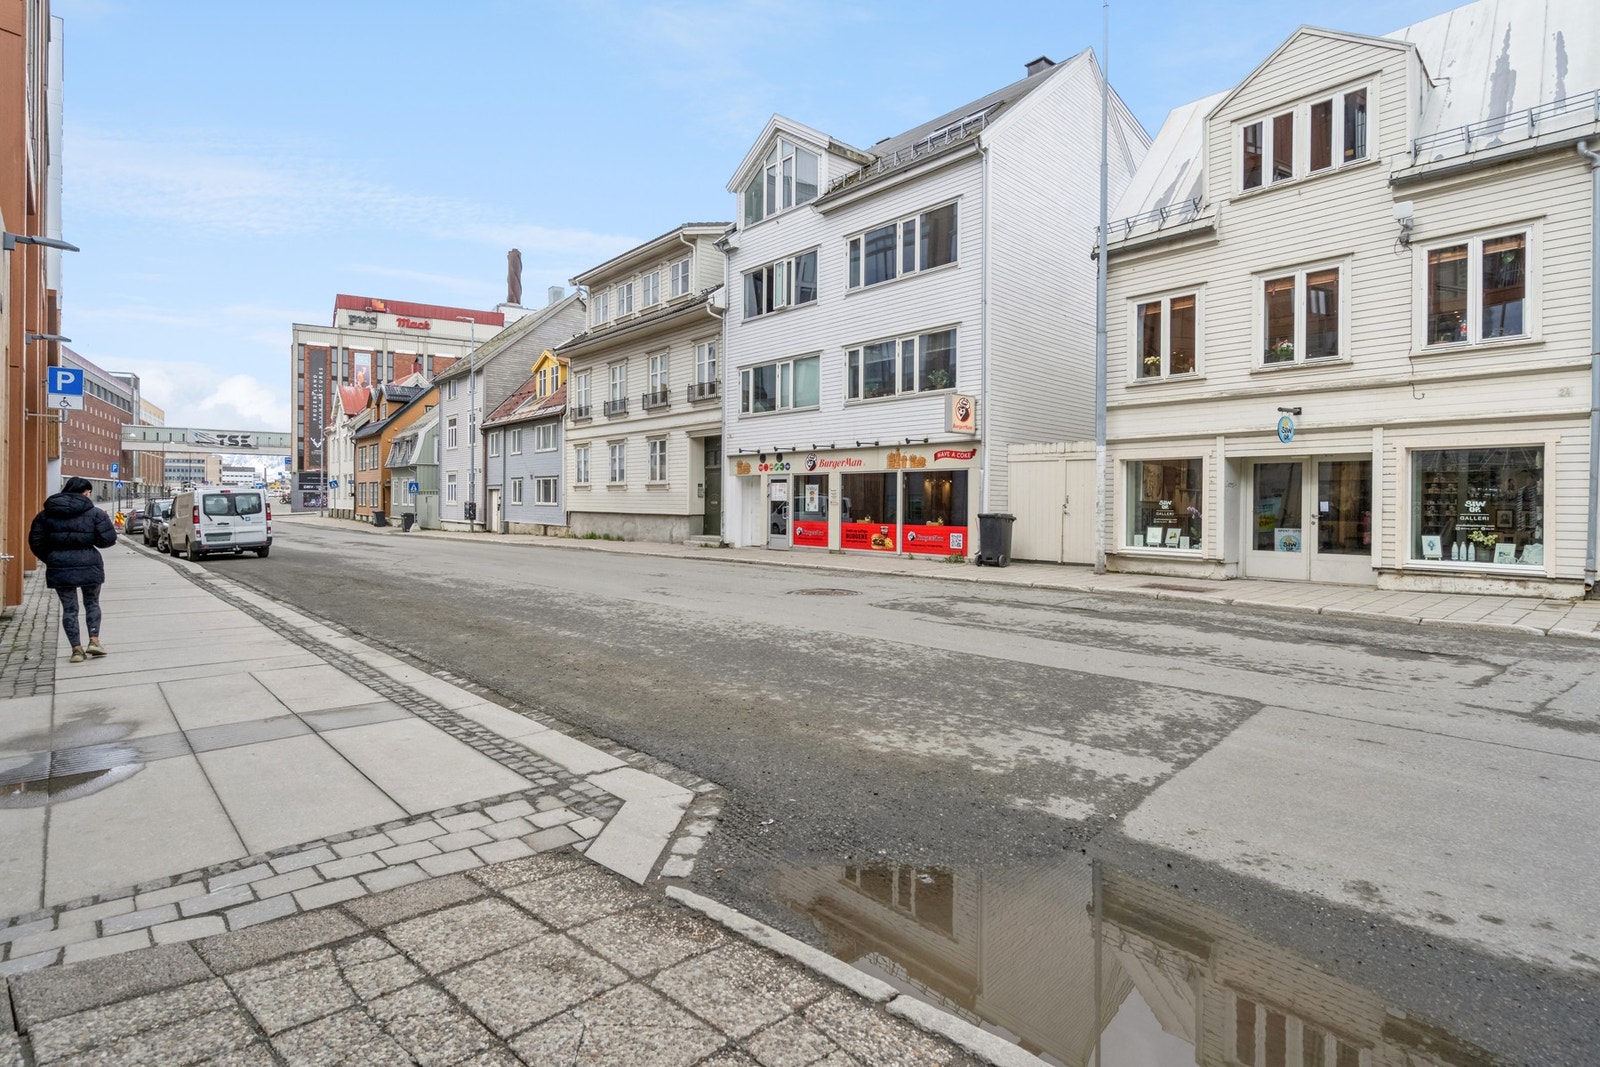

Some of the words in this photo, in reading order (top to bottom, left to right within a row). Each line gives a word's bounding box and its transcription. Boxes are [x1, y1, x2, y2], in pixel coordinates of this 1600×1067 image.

[348, 314, 377, 326] pwc
[396, 317, 431, 330] Mack
[56, 370, 76, 391] P
[216, 434, 252, 448] TSE
[112, 463, 118, 472] P
[819, 458, 863, 470] BurgerMan
